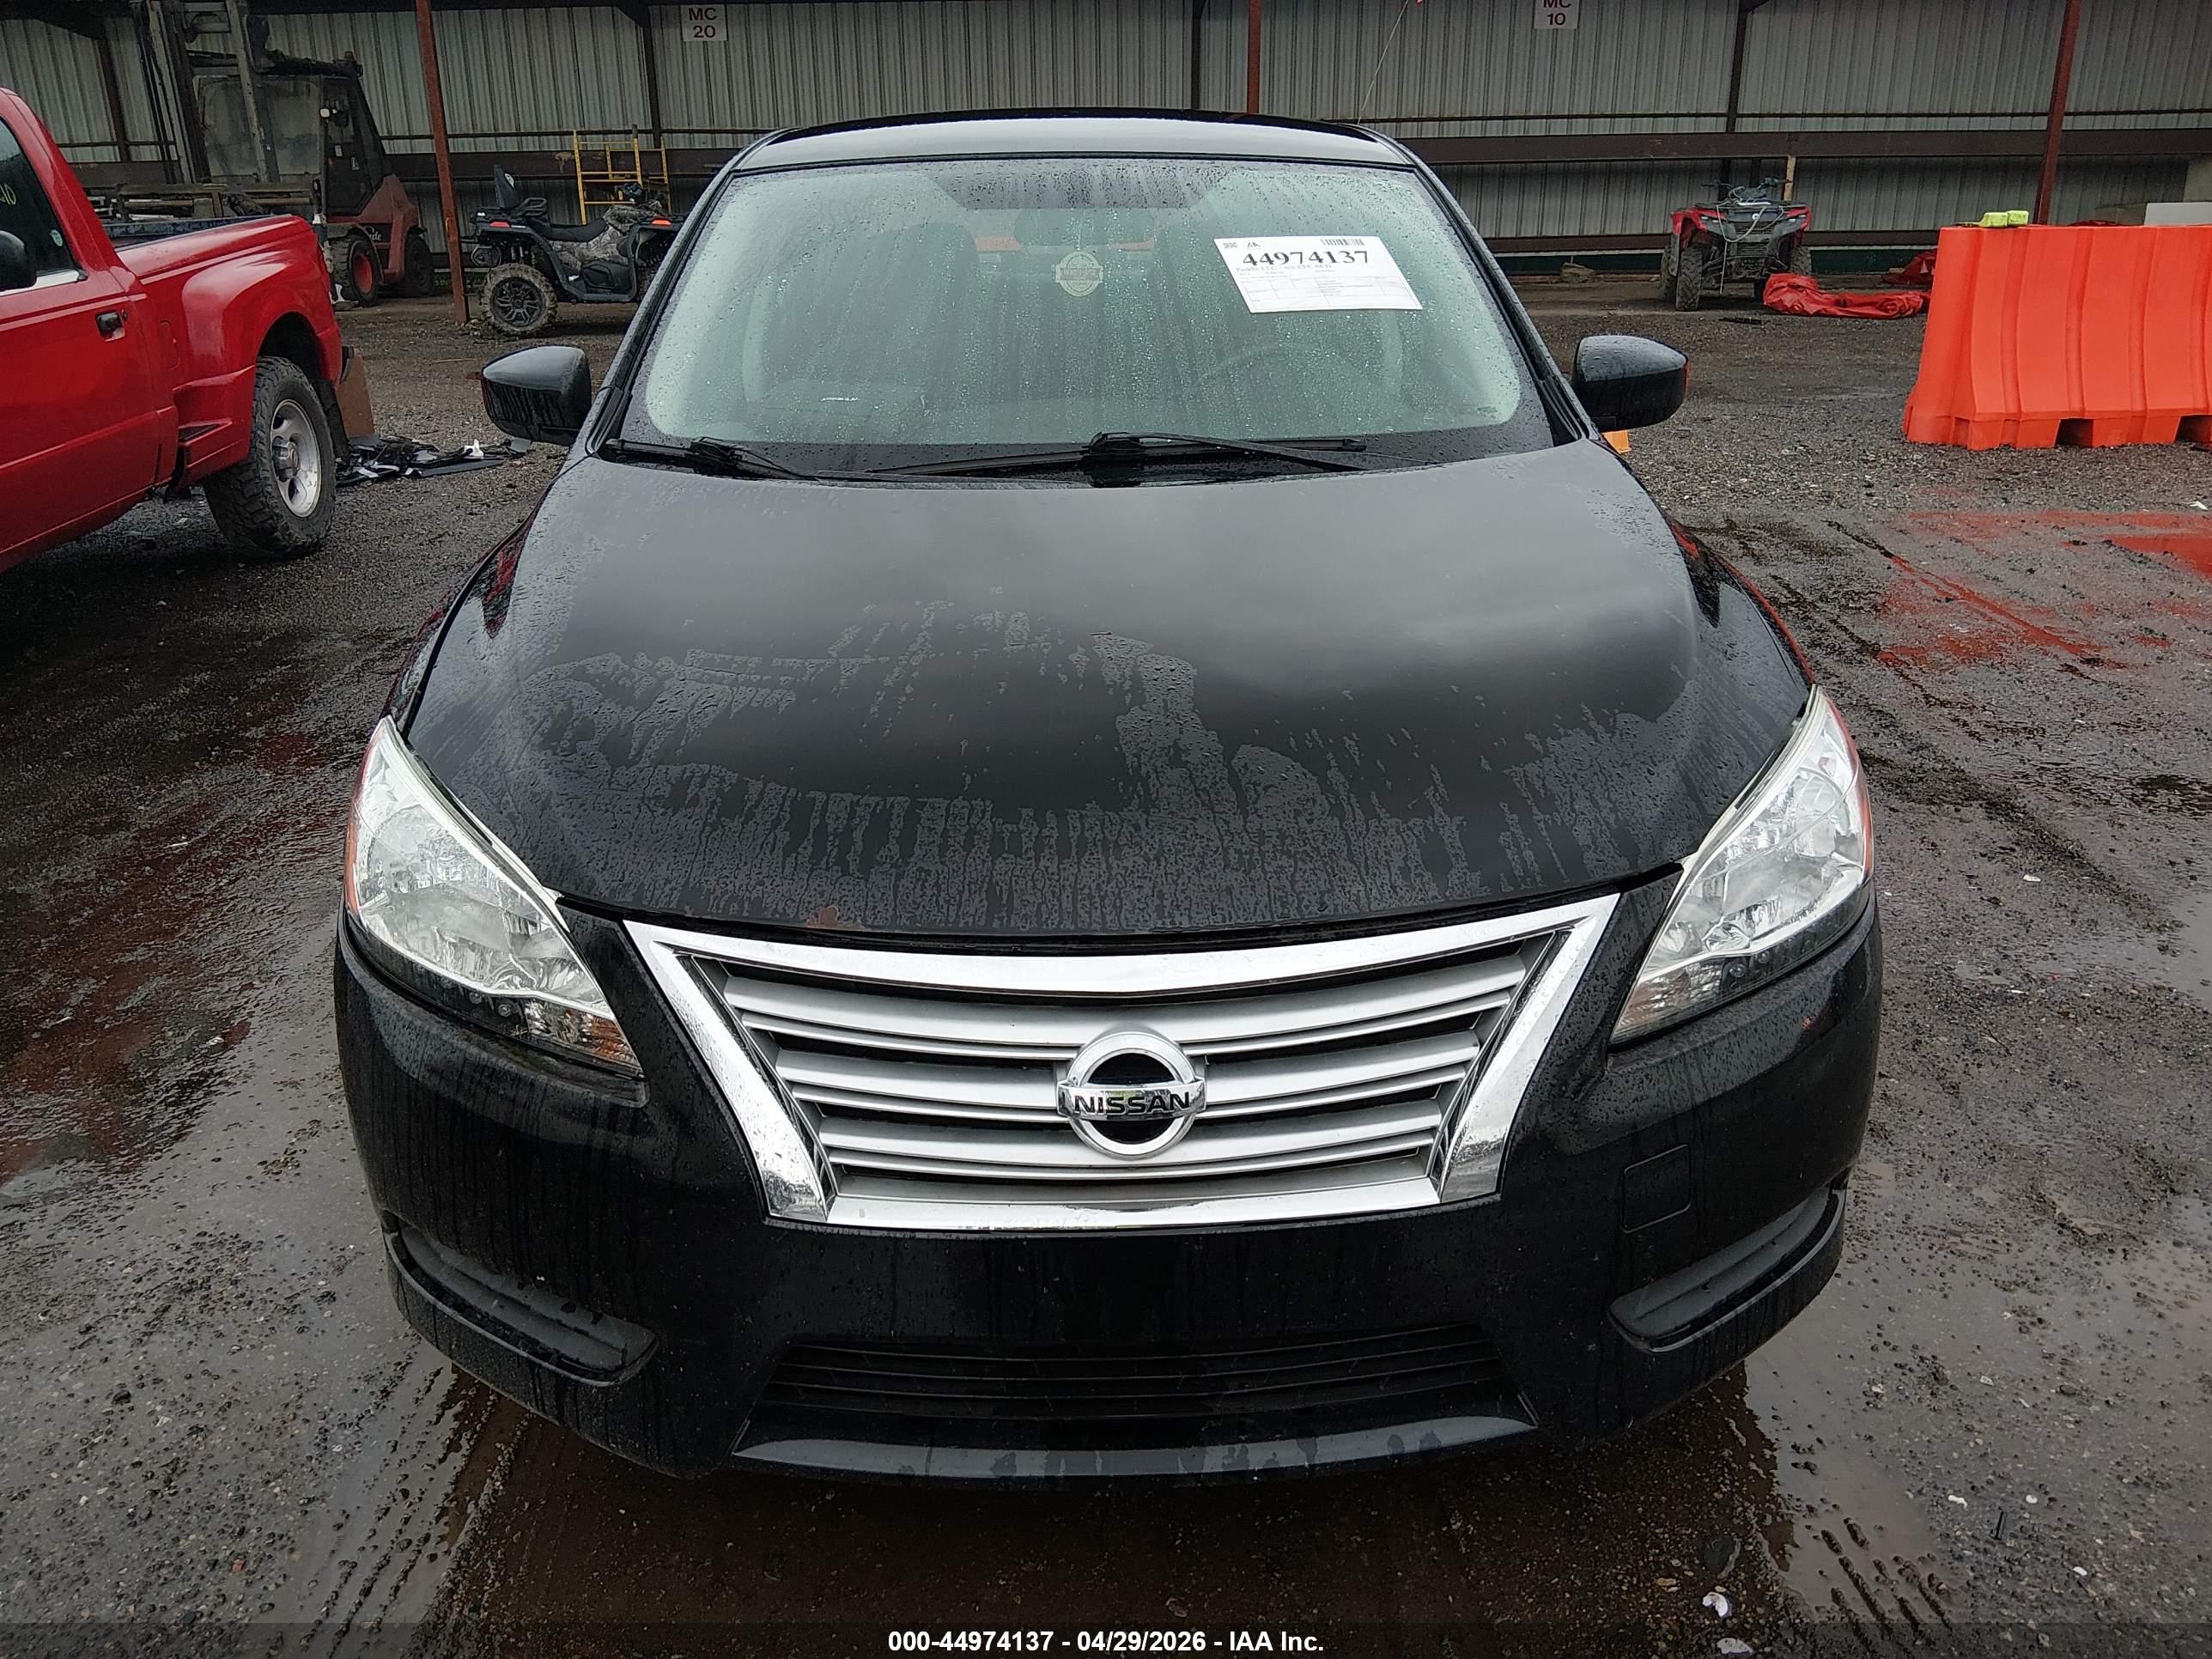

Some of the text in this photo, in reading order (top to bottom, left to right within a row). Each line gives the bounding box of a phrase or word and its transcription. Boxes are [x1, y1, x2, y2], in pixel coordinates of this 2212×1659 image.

[689, 7, 717, 21] MC
[1547, 13, 1566, 26] 10
[693, 25, 716, 38] 20
[1243, 250, 1368, 266] 44974137
[1074, 1091, 1190, 1114] NISSAN
